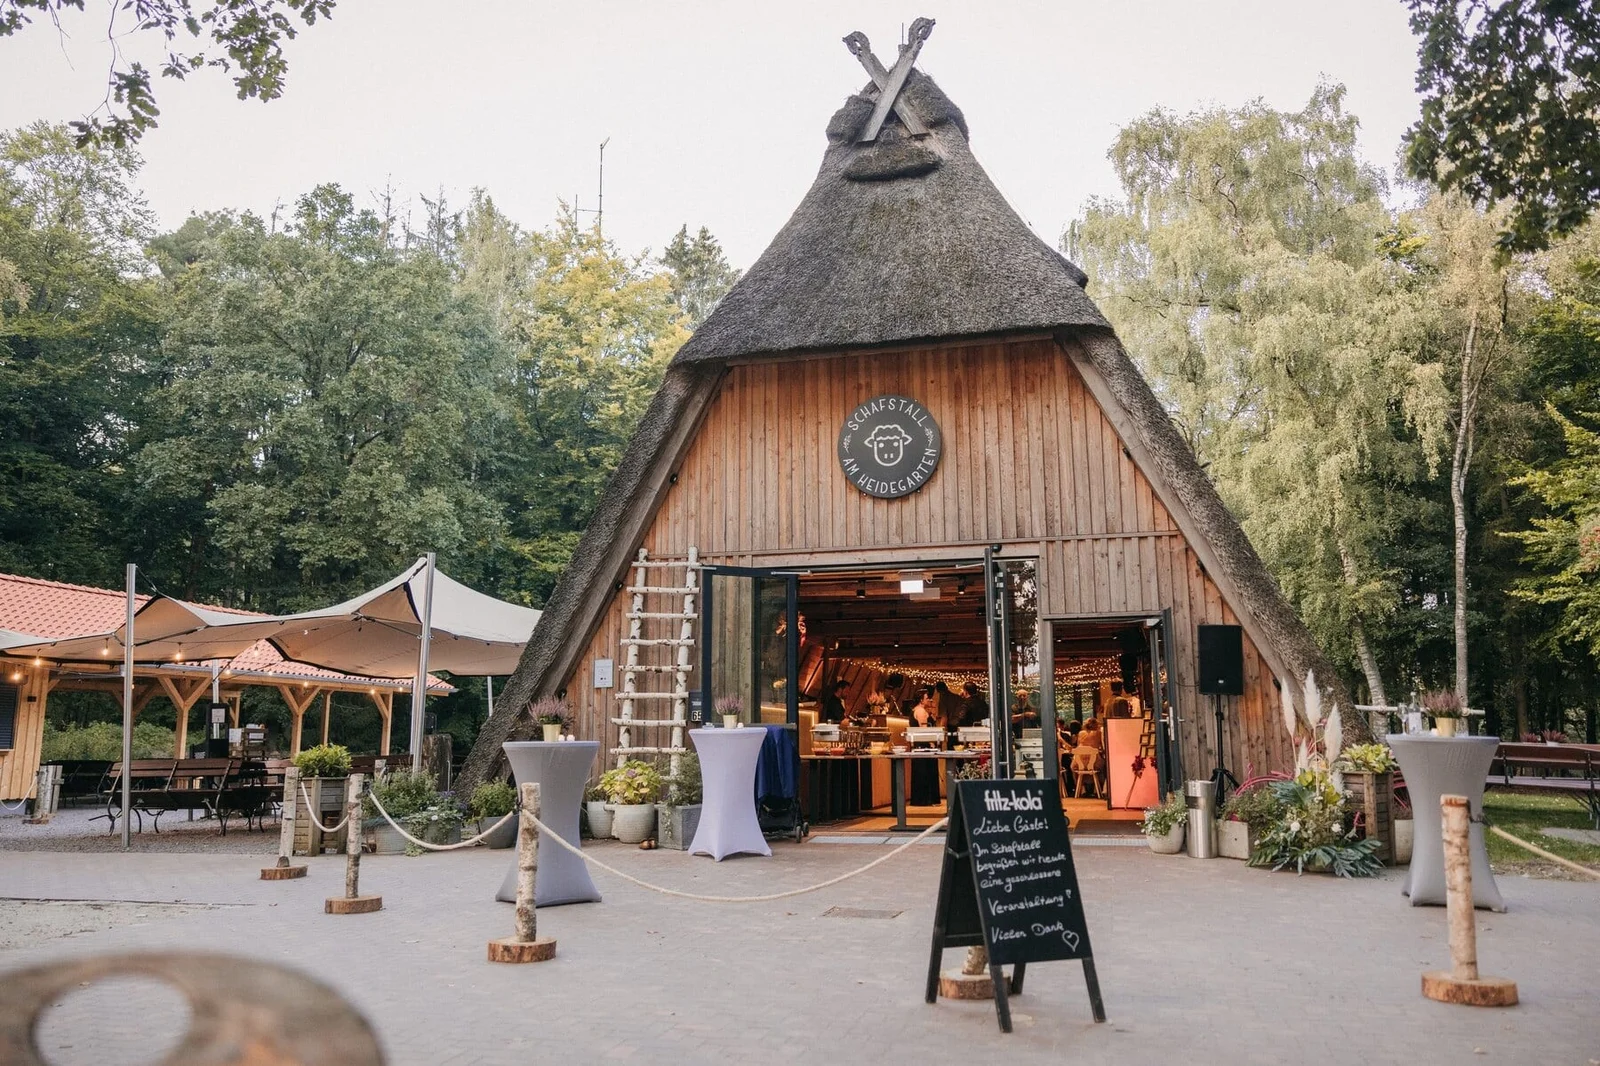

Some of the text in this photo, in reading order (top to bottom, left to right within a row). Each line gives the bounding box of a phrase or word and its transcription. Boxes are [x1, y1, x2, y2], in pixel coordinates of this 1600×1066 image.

[847, 398, 927, 431] SCHAFSTALL
[843, 448, 937, 494] AM HEIDEGARTEN
[973, 817, 1010, 835] Liebe
[973, 840, 1041, 857] Im Schafstall
[1022, 855, 1036, 866] wir
[980, 876, 1004, 889] eine
[991, 920, 1065, 943] Vielen Dank
